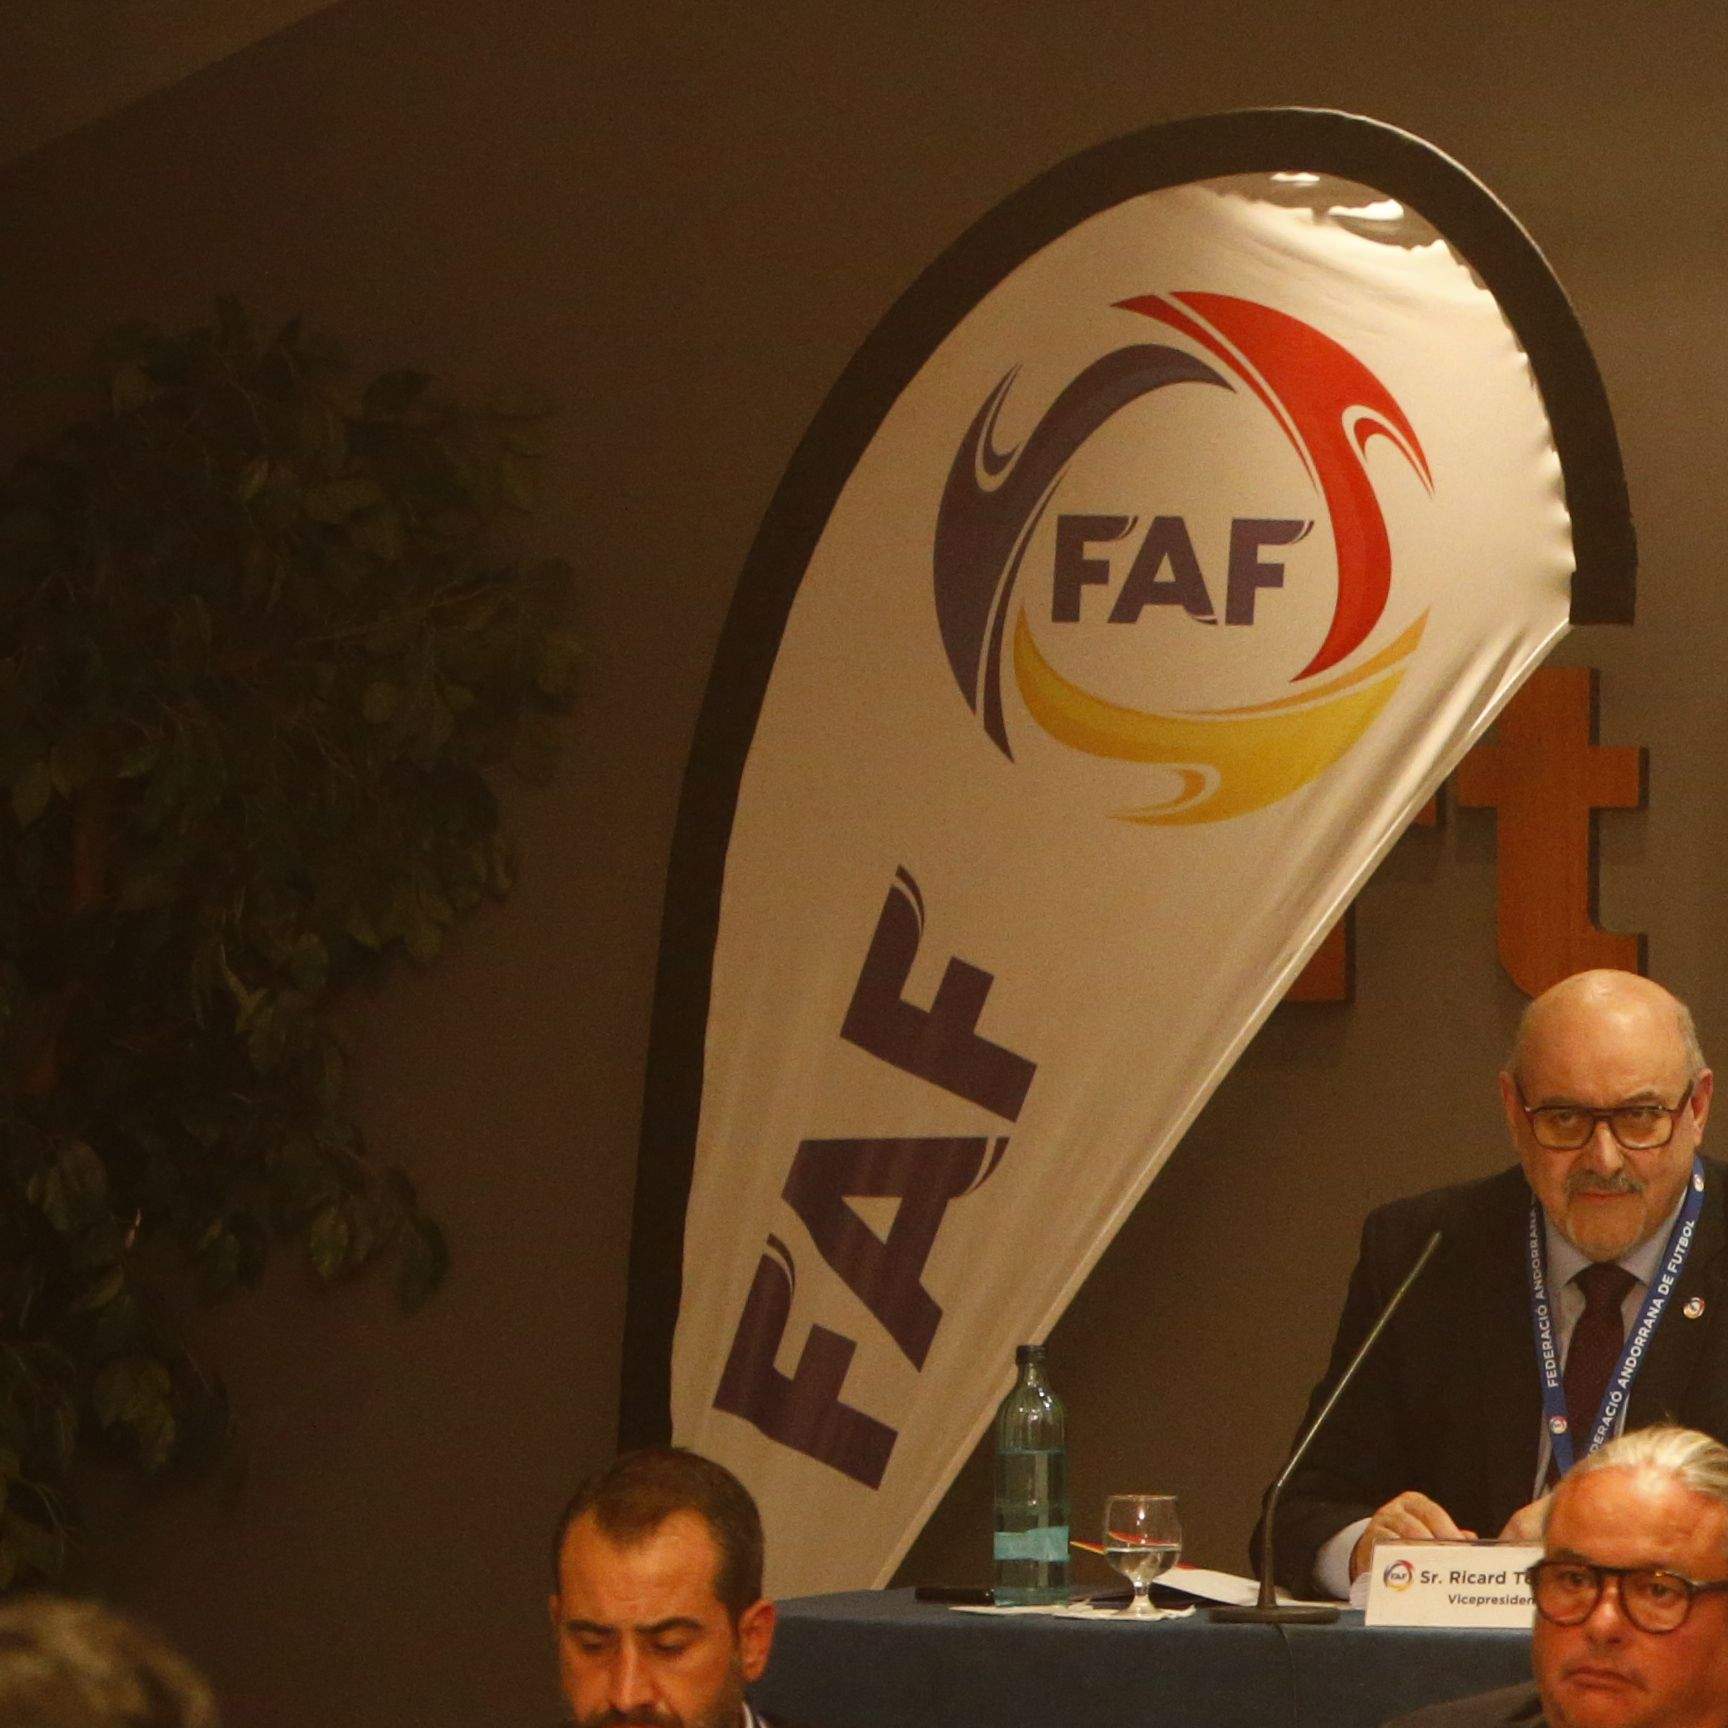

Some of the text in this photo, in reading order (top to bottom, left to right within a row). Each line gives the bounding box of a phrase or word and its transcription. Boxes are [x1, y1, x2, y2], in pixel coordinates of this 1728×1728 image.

[1050, 514, 1314, 627] FAF
[712, 864, 1037, 1490] FAF
[1535, 1304, 1559, 1388] FEDERACIÓ
[1587, 1219, 1696, 1457] DERACIÓ ANDORRANA DE FUTBOL
[1420, 1571, 1442, 1584] Sr.
[1449, 1570, 1507, 1585] Ricard
[1448, 1593, 1536, 1606] Vicepresiden
